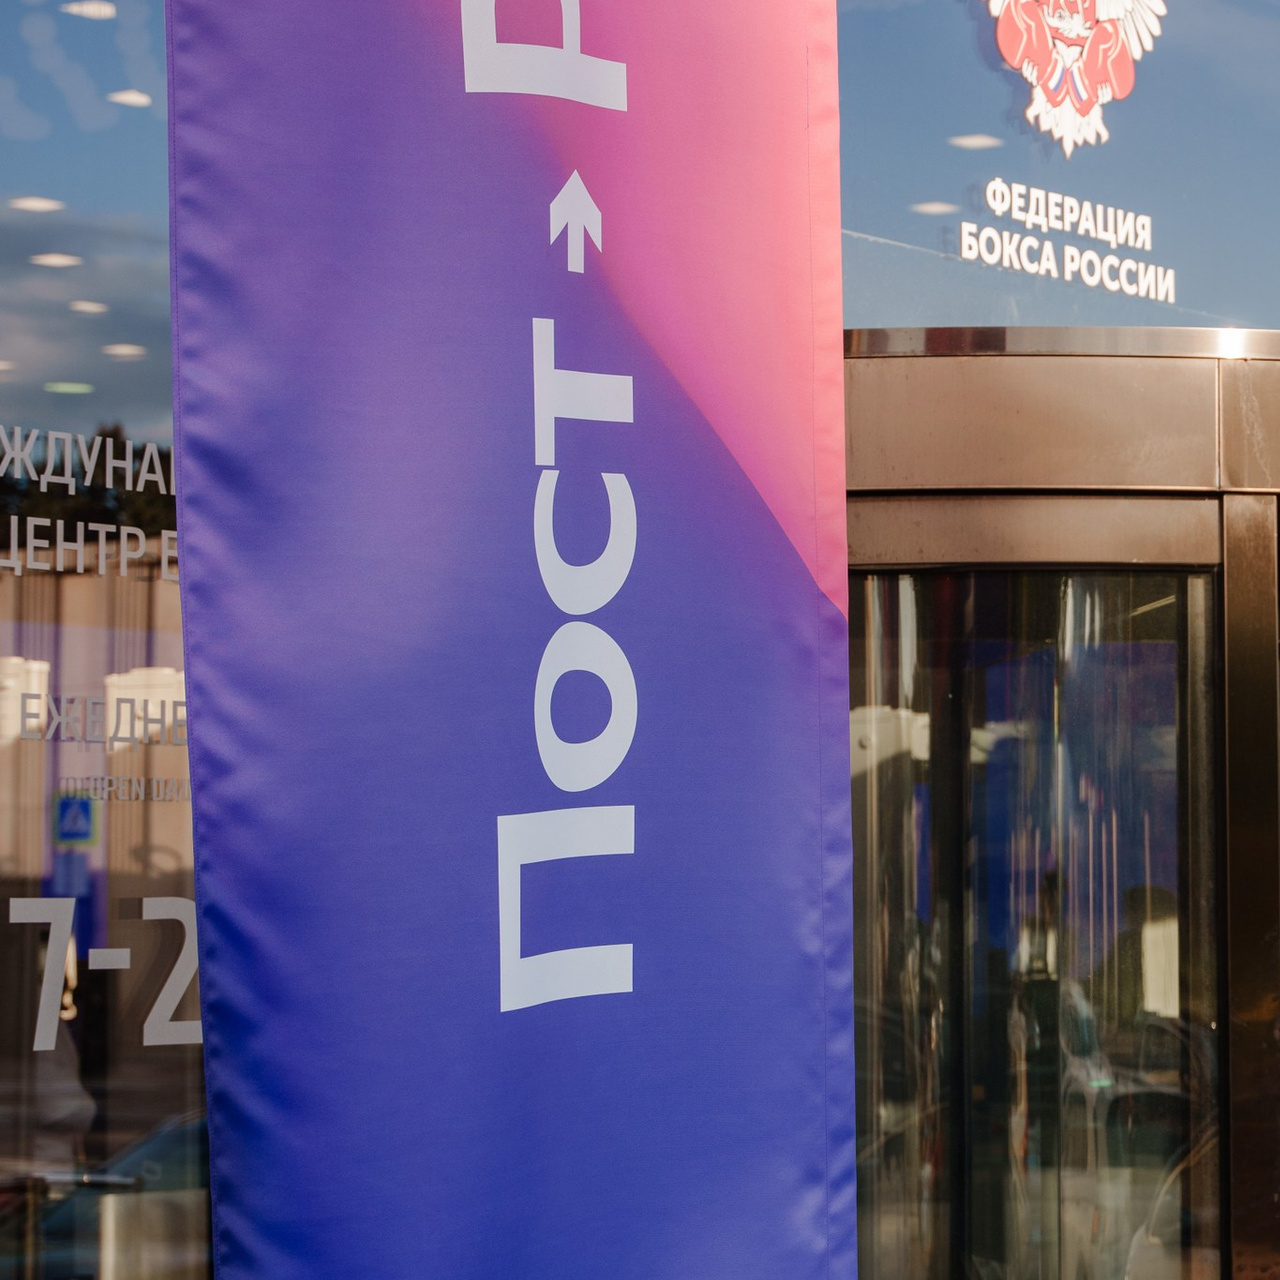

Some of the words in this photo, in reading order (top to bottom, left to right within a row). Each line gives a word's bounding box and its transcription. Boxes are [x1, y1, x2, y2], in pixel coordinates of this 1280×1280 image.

[986, 177, 1152, 251] ФЕДЕРАЦИЯ
[961, 221, 1059, 279] БОКСА
[1063, 244, 1176, 304] РОССИИ
[0, 424, 176, 496] ЖДУНА
[497, 317, 638, 1013] Пост
[88, 775, 146, 802] OPEN
[152, 777, 191, 803] DAI
